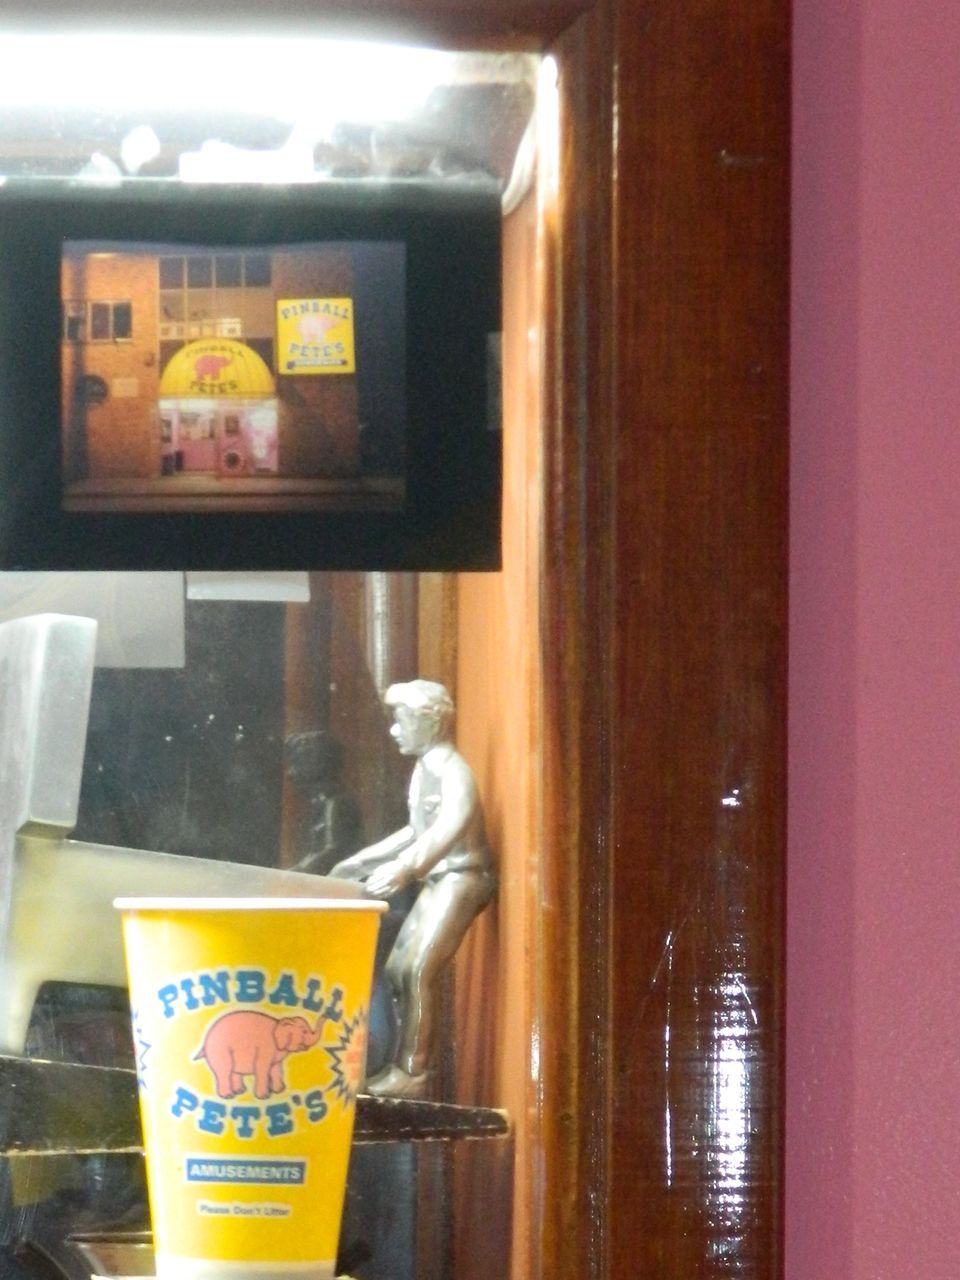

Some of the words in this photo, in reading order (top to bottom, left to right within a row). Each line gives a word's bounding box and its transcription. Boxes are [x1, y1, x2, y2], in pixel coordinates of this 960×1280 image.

[281, 300, 350, 320] PINBALL
[289, 342, 345, 358] PETE'S
[158, 970, 344, 1022] PINBALL
[171, 1087, 328, 1138] PETE'S
[190, 1164, 301, 1180] AMUSEMENTS
